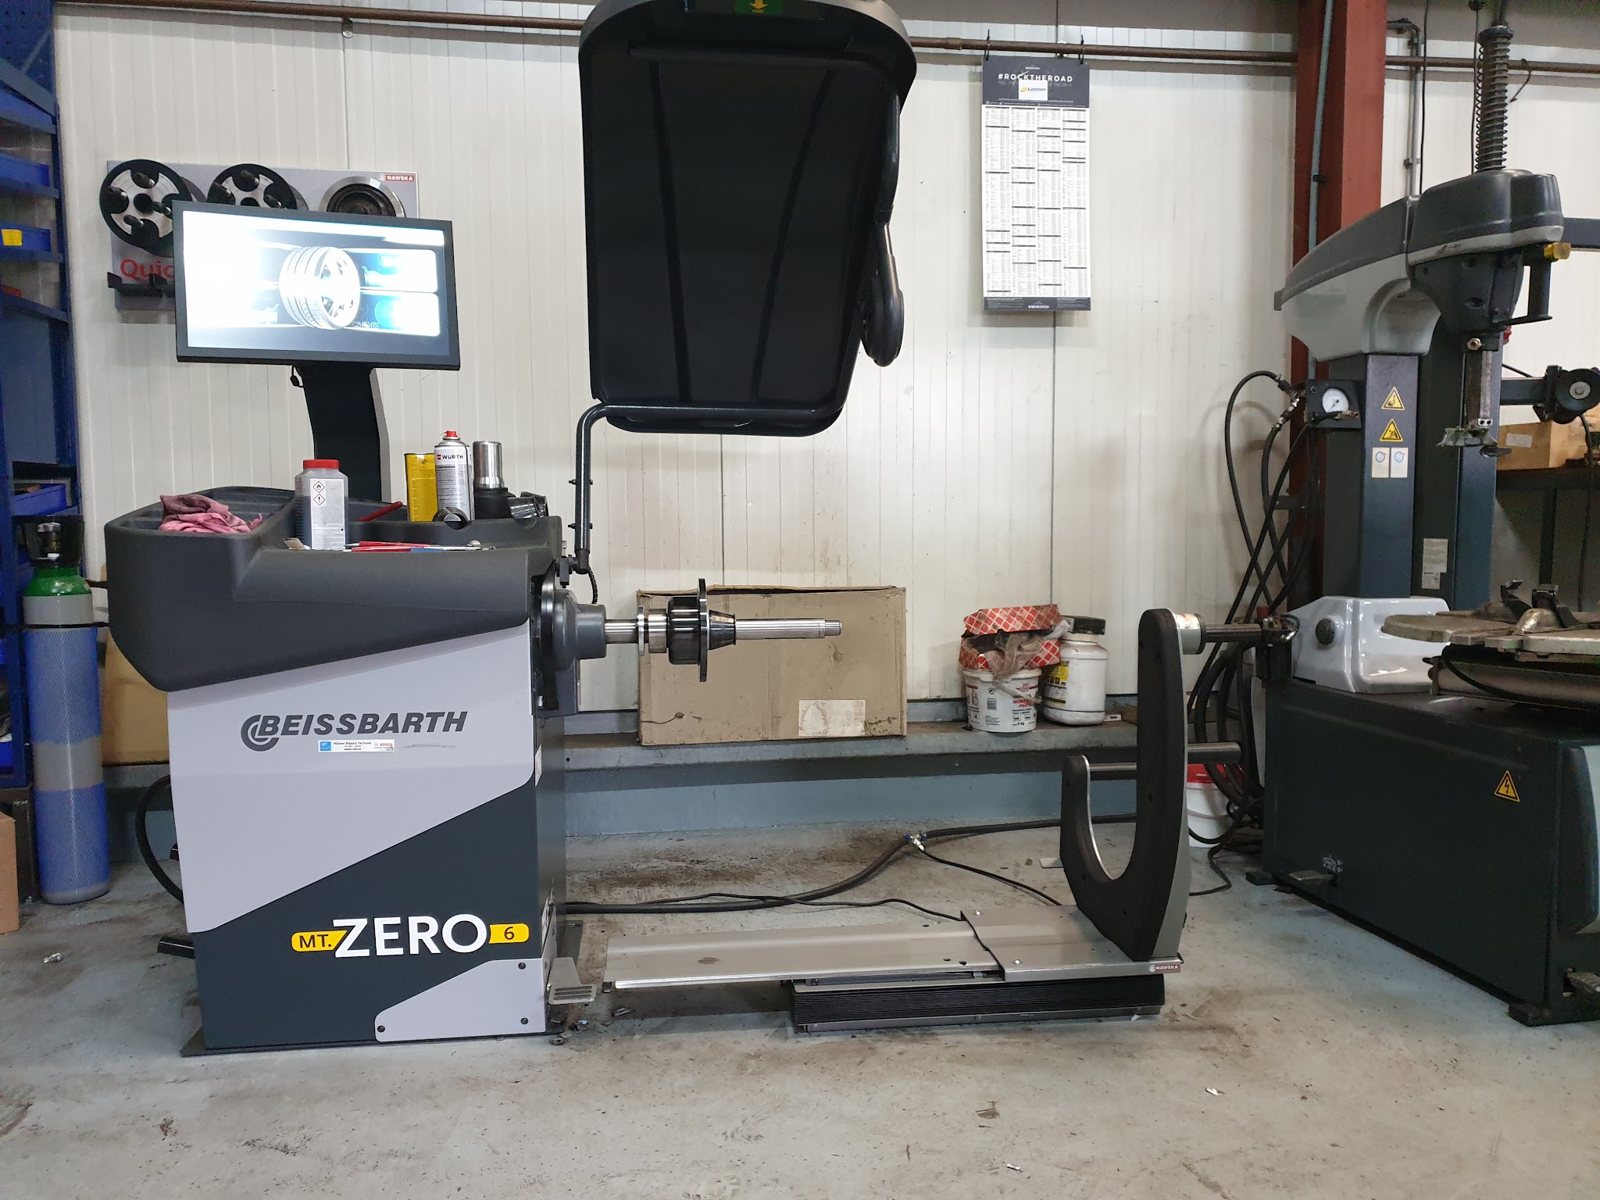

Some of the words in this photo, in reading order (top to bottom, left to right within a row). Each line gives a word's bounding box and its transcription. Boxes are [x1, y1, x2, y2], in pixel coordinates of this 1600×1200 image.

[998, 71, 1073, 83] #ROCKTHEROAD
[257, 711, 468, 737] BEISSBARTH
[299, 934, 332, 949] MT.
[332, 913, 488, 958] ZERO
[503, 926, 515, 941] 6
